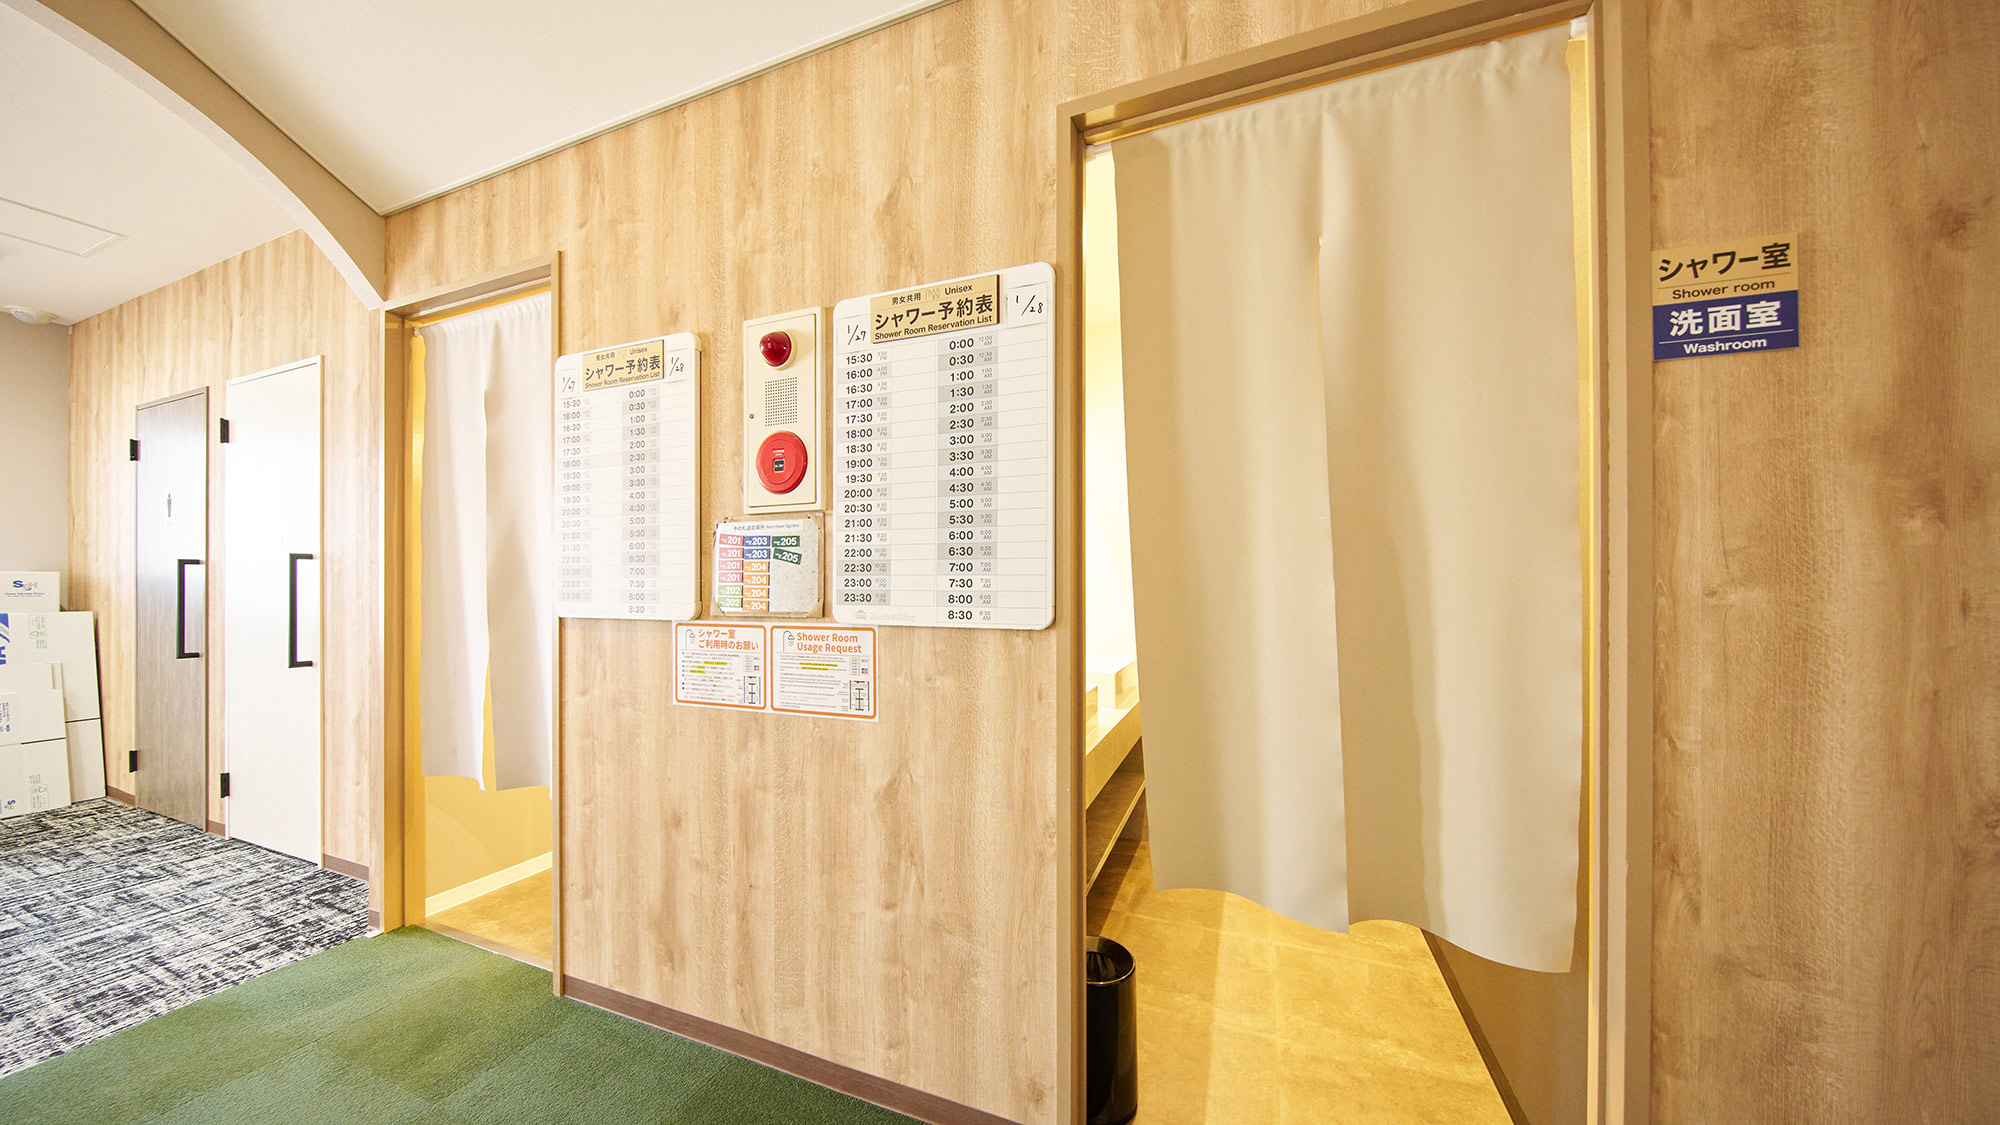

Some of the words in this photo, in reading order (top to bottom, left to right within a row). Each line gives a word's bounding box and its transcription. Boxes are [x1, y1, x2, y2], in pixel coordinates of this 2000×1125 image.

[1659, 243, 1791, 281] シャワー室
[945, 284, 973, 295] Unisex
[1672, 286, 1728, 299] Shower
[1734, 281, 1775, 292] room
[892, 293, 921, 305] 男女共用
[875, 294, 993, 330] シャワー予約表
[1670, 301, 1781, 336] 洗面室
[875, 330, 902, 340] Shower
[904, 326, 926, 335] Room
[928, 318, 975, 332] Reservation
[977, 315, 992, 323] List
[950, 338, 974, 350] 0:00
[1683, 339, 1767, 354] Washroom
[630, 347, 648, 355] Unisex
[846, 351, 872, 364] 15:30
[950, 354, 974, 366] 0:30
[585, 355, 660, 381] シャワー予約表
[846, 368, 872, 379] 16:00
[950, 370, 974, 381] 1:00
[585, 381, 603, 389] Shower
[604, 378, 618, 386] Room
[619, 373, 649, 383] Reservation
[629, 389, 646, 398] 0:00
[846, 384, 872, 394] 16:30
[950, 386, 974, 397] 1:30
[562, 400, 581, 408] 15:30
[629, 402, 646, 411] 0:30
[846, 398, 872, 408] 17:00
[950, 402, 974, 413] 2:00
[562, 412, 581, 420] 16:00
[629, 415, 646, 423] 1:00
[846, 414, 872, 424] 17:30
[562, 423, 581, 432] 16:30
[950, 419, 974, 429] 2:30
[629, 427, 646, 436] 1:30
[846, 428, 872, 438] 18:00
[562, 436, 581, 444] 17:00
[629, 440, 646, 449] 2:00
[950, 435, 974, 445] 3:00
[562, 448, 581, 456] 17:30
[846, 444, 872, 453] 18:30
[629, 453, 646, 462] 2:30
[950, 451, 974, 461] 3:30
[562, 460, 581, 468] 18:00
[846, 459, 872, 468] 19:00
[629, 465, 646, 474] 3:00
[950, 467, 974, 476] 4:00
[562, 472, 581, 480] 18:30
[846, 474, 872, 483] 19:30
[629, 478, 646, 487] 3:30
[562, 484, 581, 492] 19:00
[950, 483, 974, 492] 4:30
[629, 491, 646, 500] 4:00
[845, 489, 872, 498] 20:00
[562, 496, 581, 504] 19:30
[950, 499, 973, 508] 5:00
[562, 508, 581, 516] 20:00
[629, 504, 646, 512] 4:30
[845, 504, 872, 513] 20:30
[562, 520, 581, 528] 20:30
[629, 516, 646, 525] 5:00
[845, 519, 872, 528] 21:00
[950, 515, 973, 524] 5:30
[562, 532, 581, 540] 21:00
[629, 529, 646, 538] 5:30
[845, 534, 872, 542] 21:30
[949, 531, 973, 540] 6:00
[728, 536, 741, 544] 201
[562, 543, 581, 552] 21:30
[629, 542, 646, 550] 6:00
[845, 549, 872, 557] 22:00
[949, 547, 973, 556] 6:30
[562, 556, 581, 564] 22:00
[629, 554, 646, 563] 6:30
[782, 552, 798, 562] 205
[562, 568, 581, 576] 22:30
[629, 567, 646, 576] 7:00
[844, 564, 872, 572] 22:30
[949, 563, 973, 572] 7:00
[562, 580, 581, 588] 23:00
[629, 580, 646, 588] 7:30
[752, 576, 766, 584] 204
[844, 578, 872, 587] 23:00
[949, 579, 973, 588] 7:30
[562, 592, 581, 600] 23:30
[629, 592, 646, 601] 8:00
[844, 593, 872, 602] 23:30
[948, 594, 972, 604] 8:00
[629, 605, 646, 614] 8:30
[751, 602, 766, 610] 204
[948, 610, 972, 620] 8:30
[698, 629, 735, 639] シャワー室
[797, 633, 830, 642] Shower
[832, 634, 858, 642] Room
[699, 639, 759, 650] ご利用時のお願い
[797, 643, 823, 653] Usage
[825, 644, 861, 654] Request
